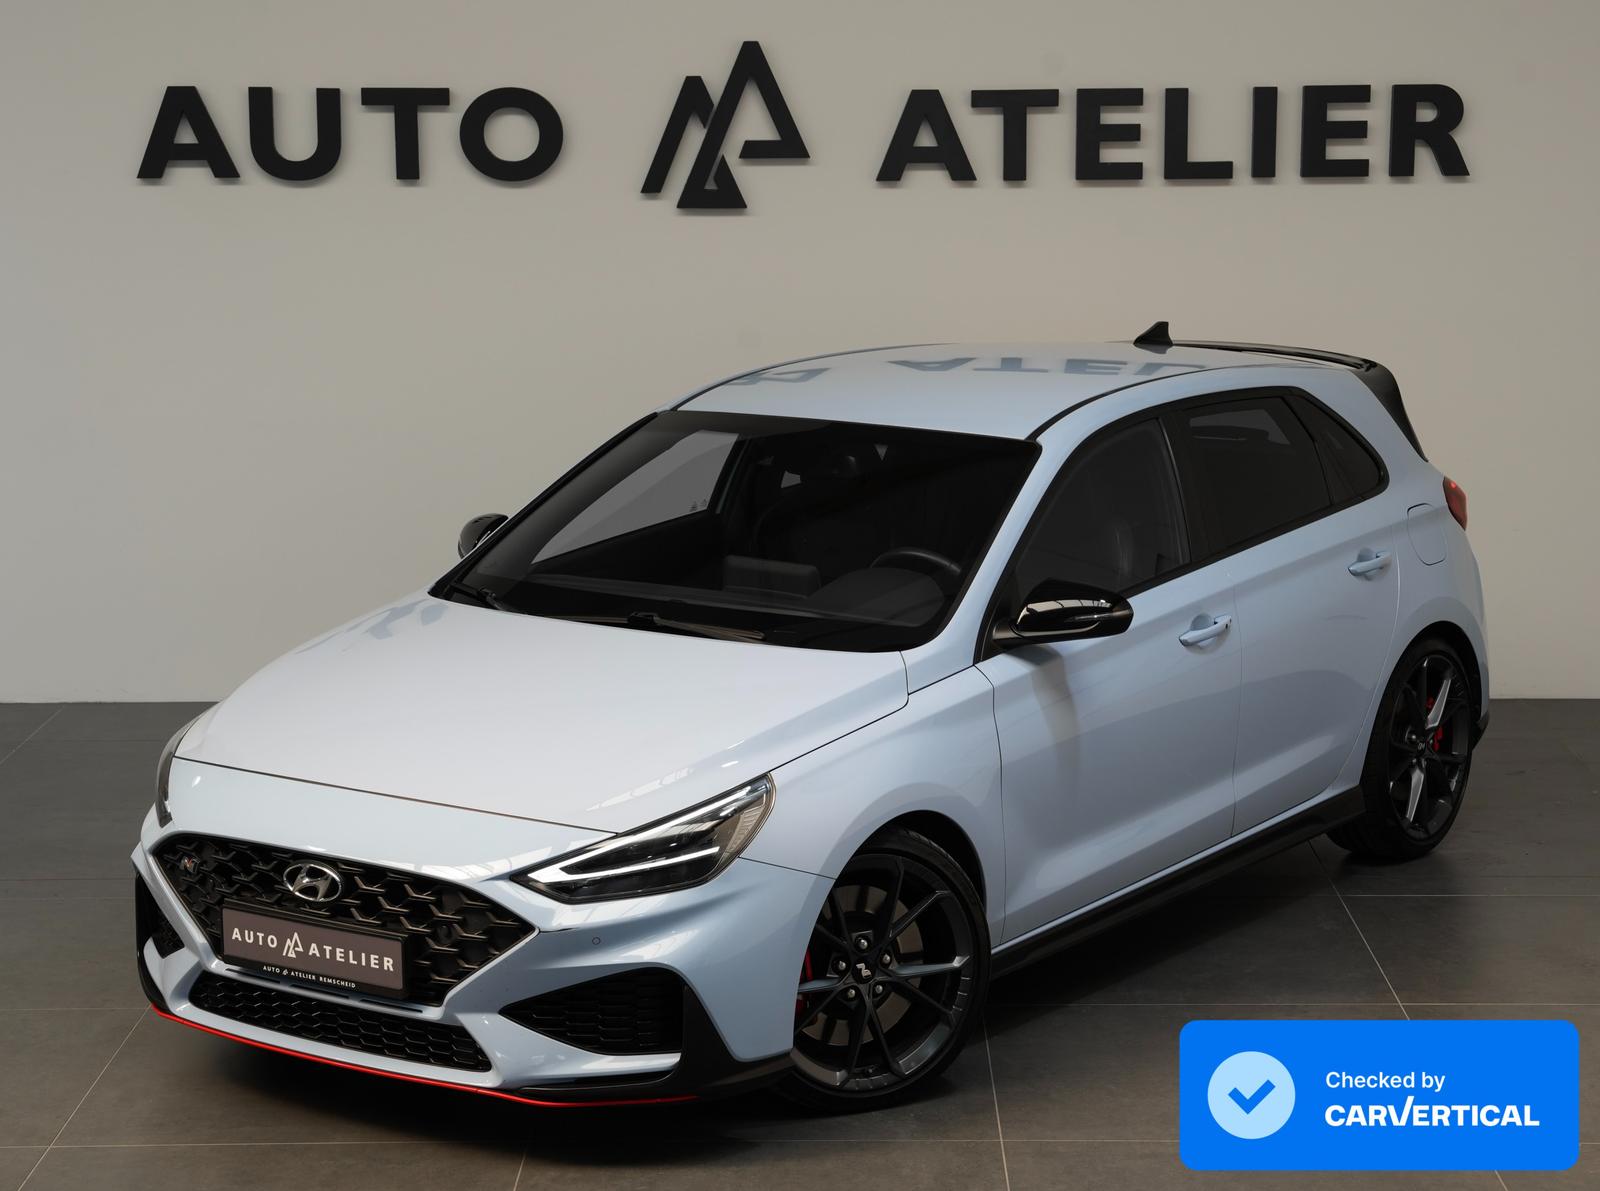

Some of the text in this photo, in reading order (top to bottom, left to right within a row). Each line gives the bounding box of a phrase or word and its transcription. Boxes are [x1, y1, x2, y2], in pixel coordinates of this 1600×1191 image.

[136, 83, 1471, 182] AUTO ATELIER
[231, 926, 394, 972] AUTO ATELIER
[262, 964, 357, 989] AUTO ATELIER REMSCHEID
